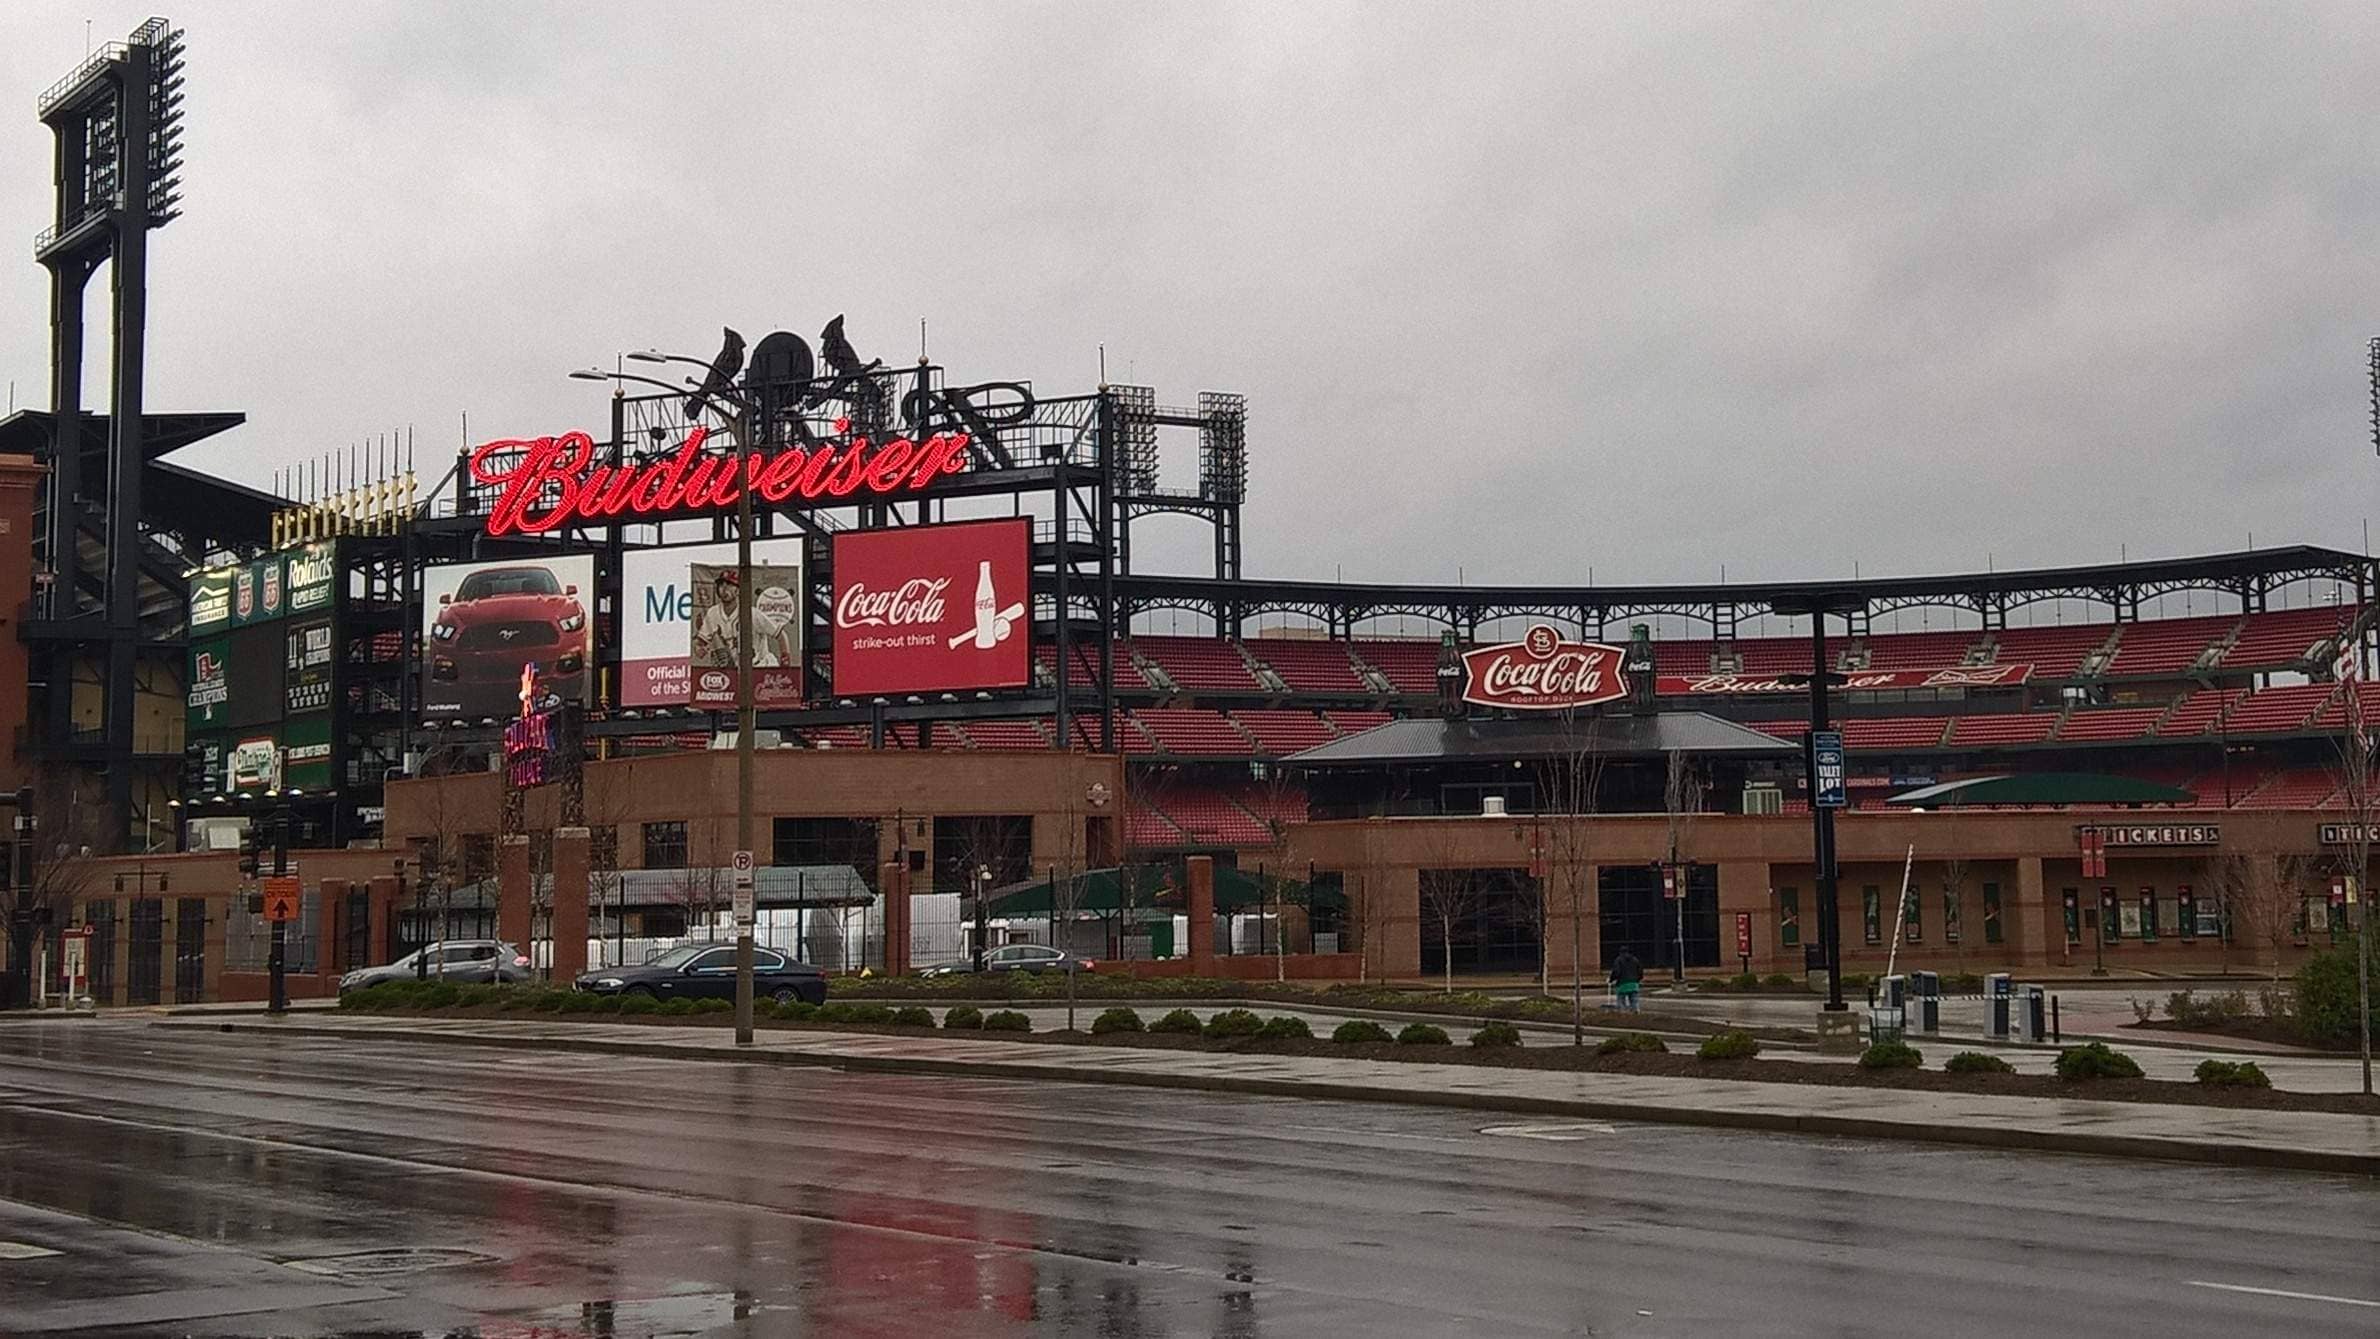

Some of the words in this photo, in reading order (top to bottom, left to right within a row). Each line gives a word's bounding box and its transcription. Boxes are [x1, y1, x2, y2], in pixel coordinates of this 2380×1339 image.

[470, 418, 968, 535] Budweiser
[288, 552, 333, 589] Rolaids
[837, 577, 952, 629] Coca-Cola
[853, 635, 904, 649] strike-out
[907, 634, 936, 646] thirst
[647, 667, 685, 679] Official
[1484, 652, 1605, 695] Coca-Cola
[651, 687, 662, 695] of
[664, 685, 679, 694] the
[1683, 674, 1896, 692] Budser
[696, 691, 735, 701] MIDWEST
[1818, 765, 1841, 777] VALET
[1819, 778, 1841, 794] LOT
[2103, 829, 2203, 842] ICKETS
